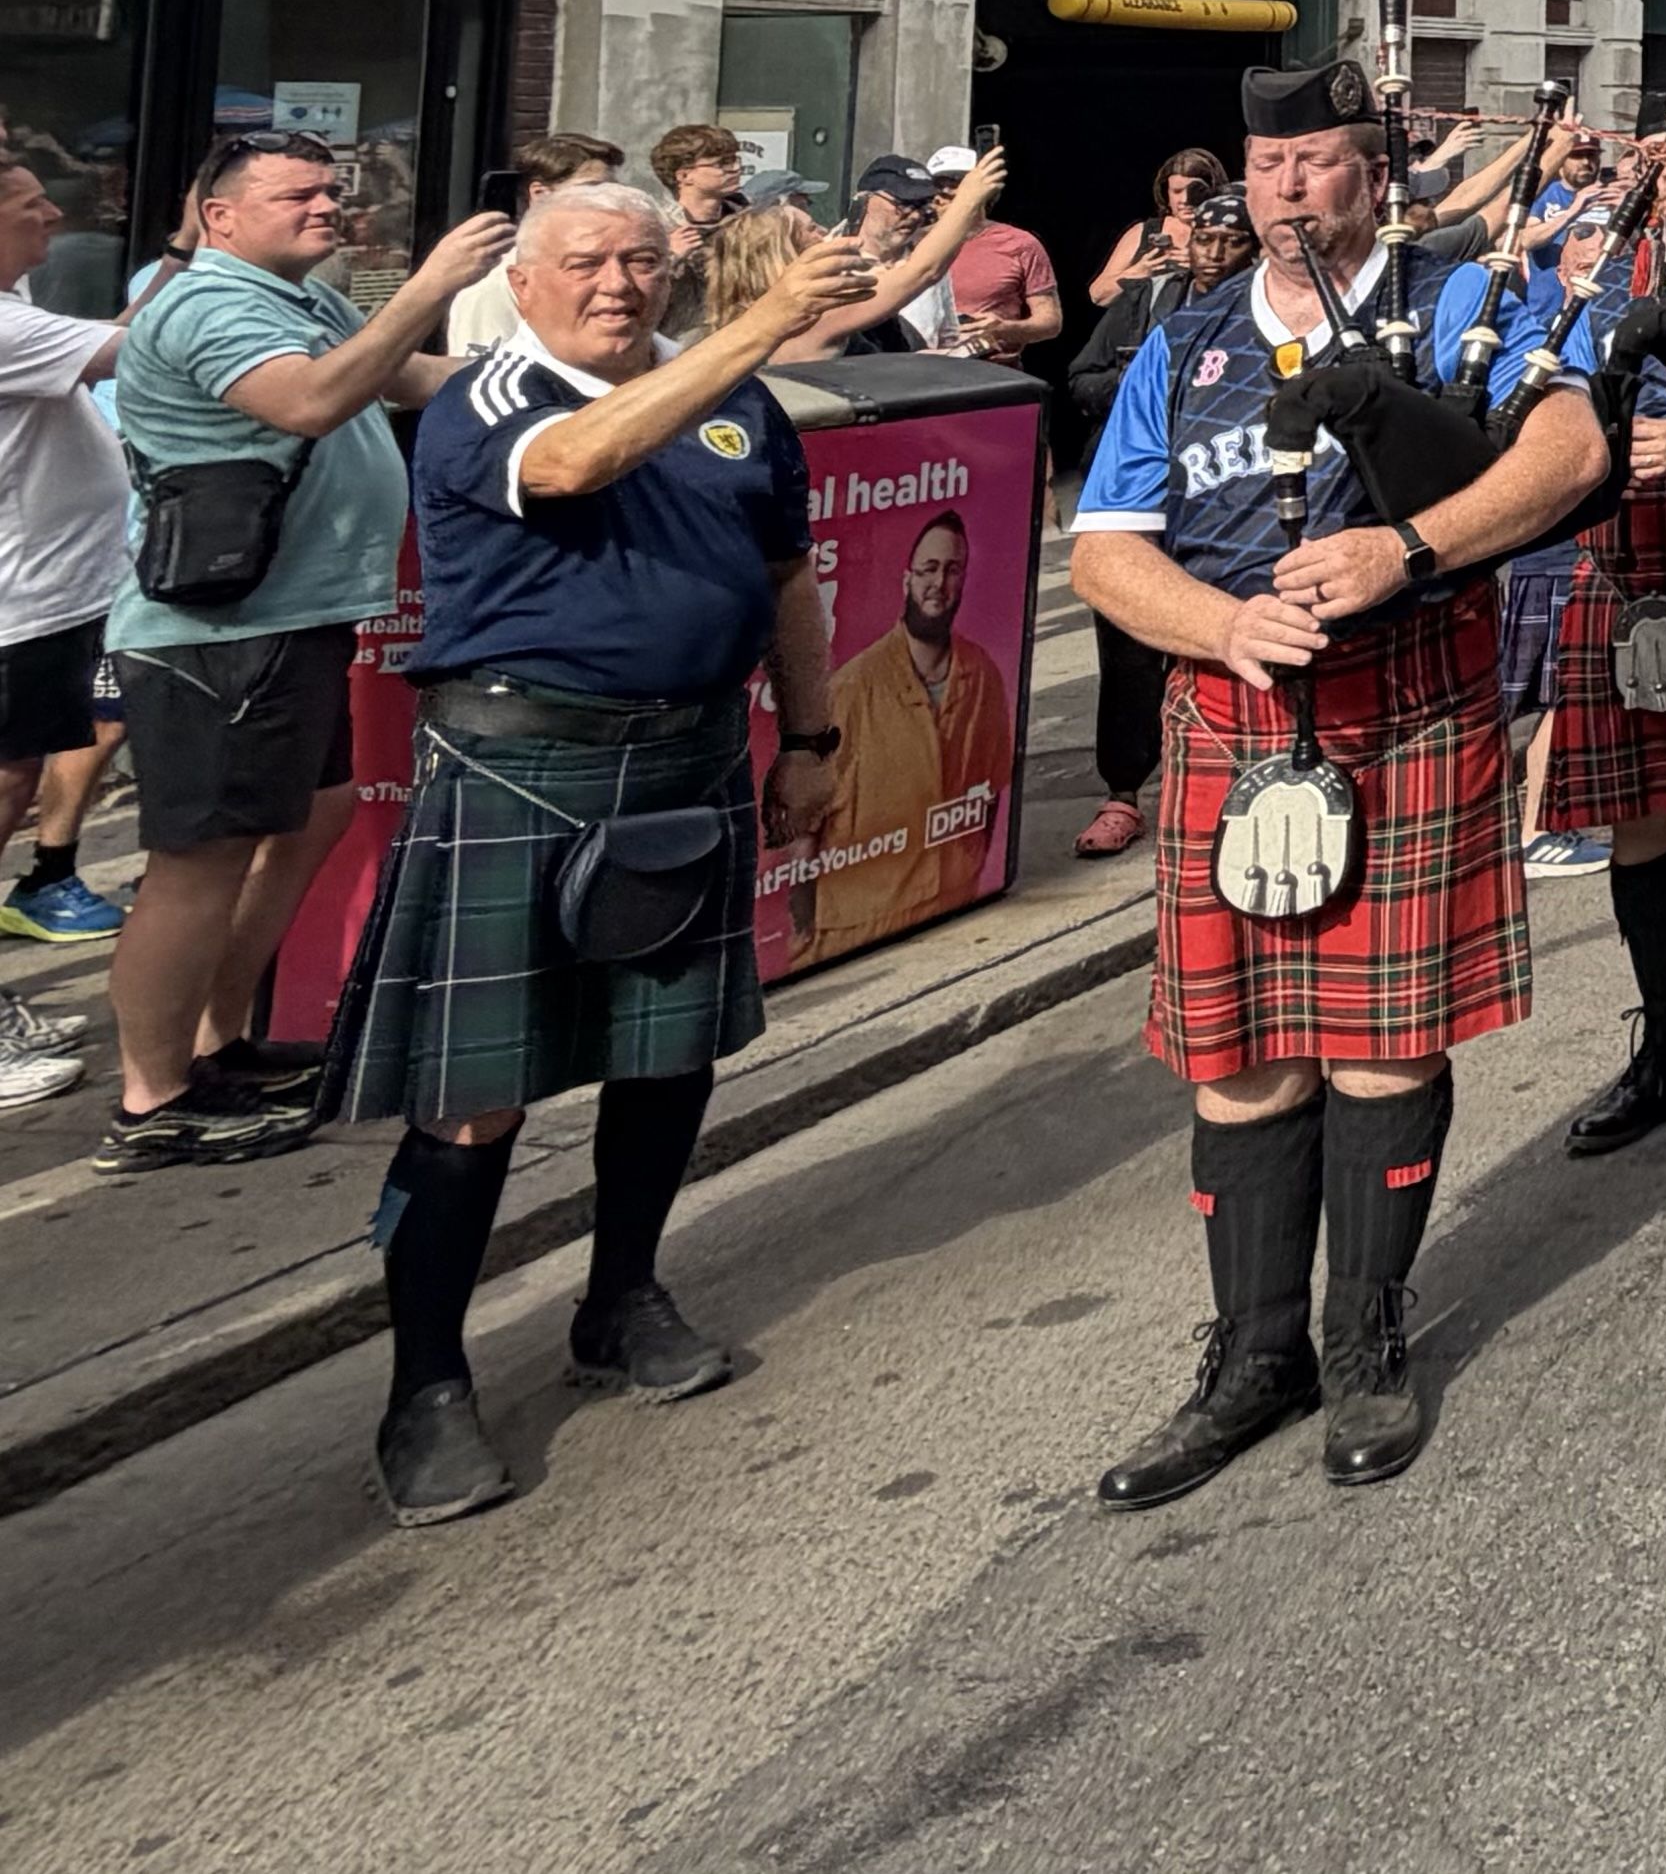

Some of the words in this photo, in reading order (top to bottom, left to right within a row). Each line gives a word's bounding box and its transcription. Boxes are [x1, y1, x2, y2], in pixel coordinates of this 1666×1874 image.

[1192, 349, 1229, 388] B
[846, 457, 969, 517] health
[931, 798, 983, 839] DPH
